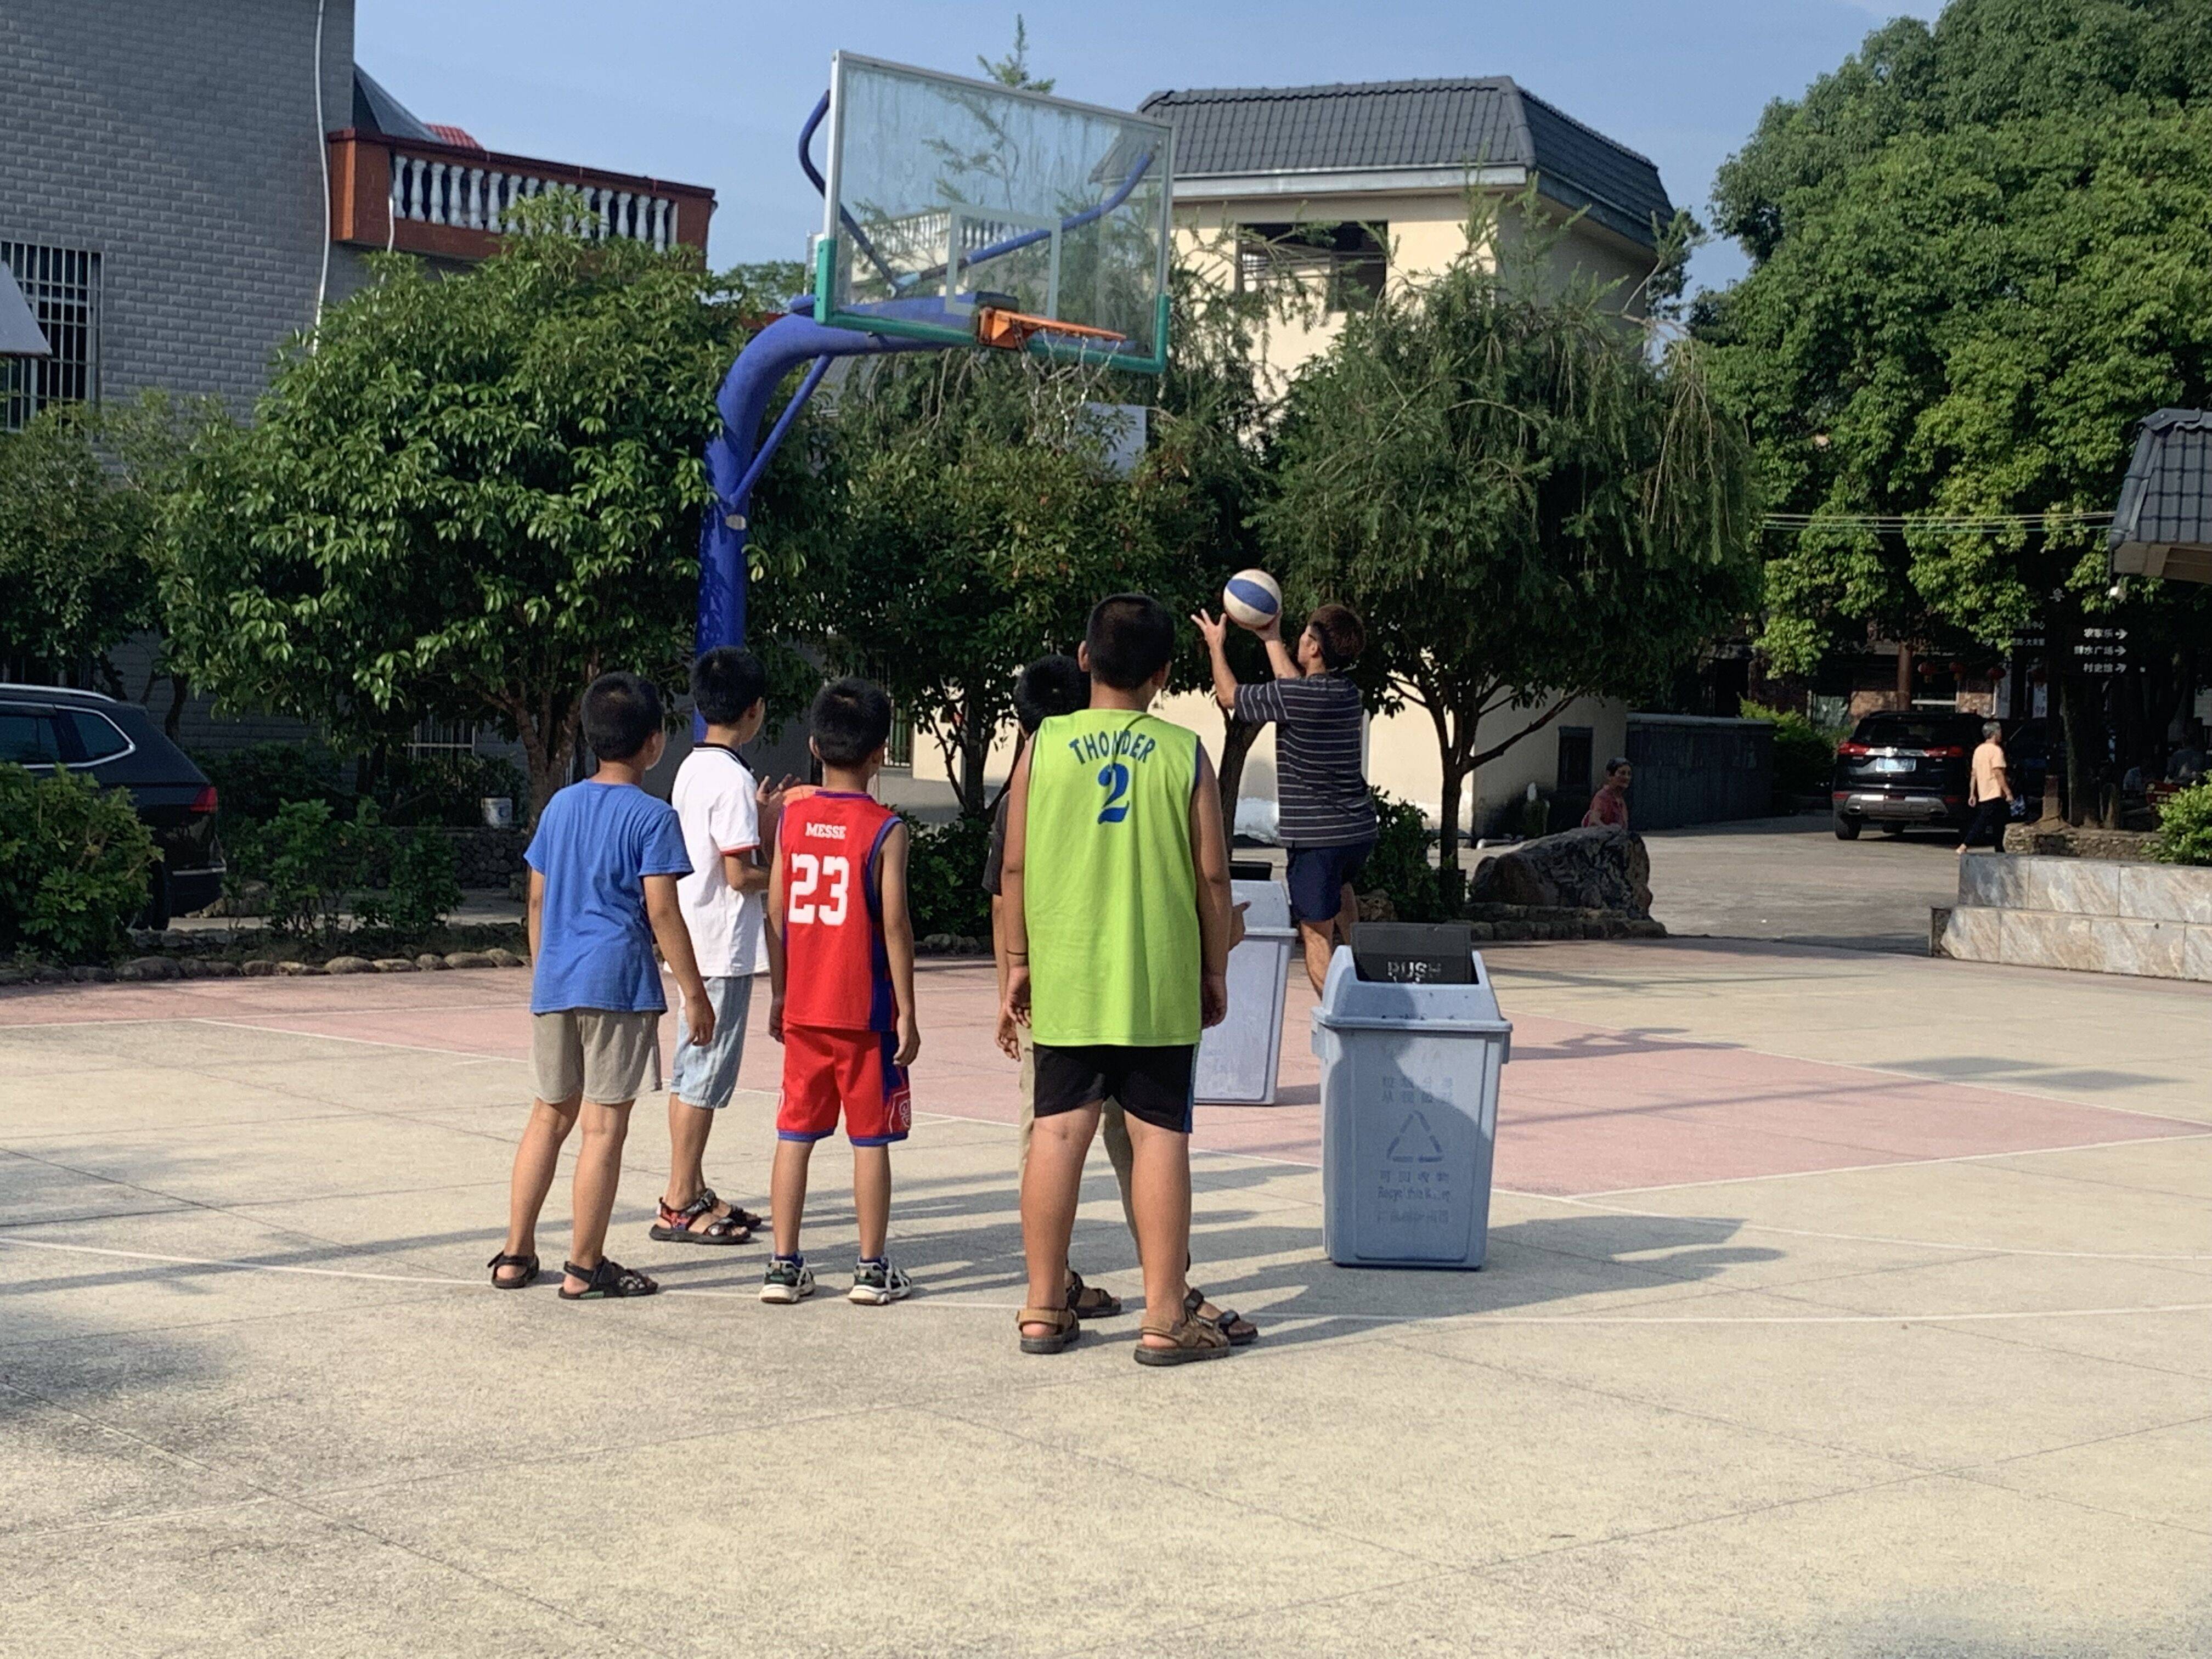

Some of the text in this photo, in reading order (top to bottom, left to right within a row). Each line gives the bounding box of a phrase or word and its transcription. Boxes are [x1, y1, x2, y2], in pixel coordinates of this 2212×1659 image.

[1097, 763, 1130, 825] 2
[805, 822, 847, 839] MESSE
[788, 853, 850, 926] 23
